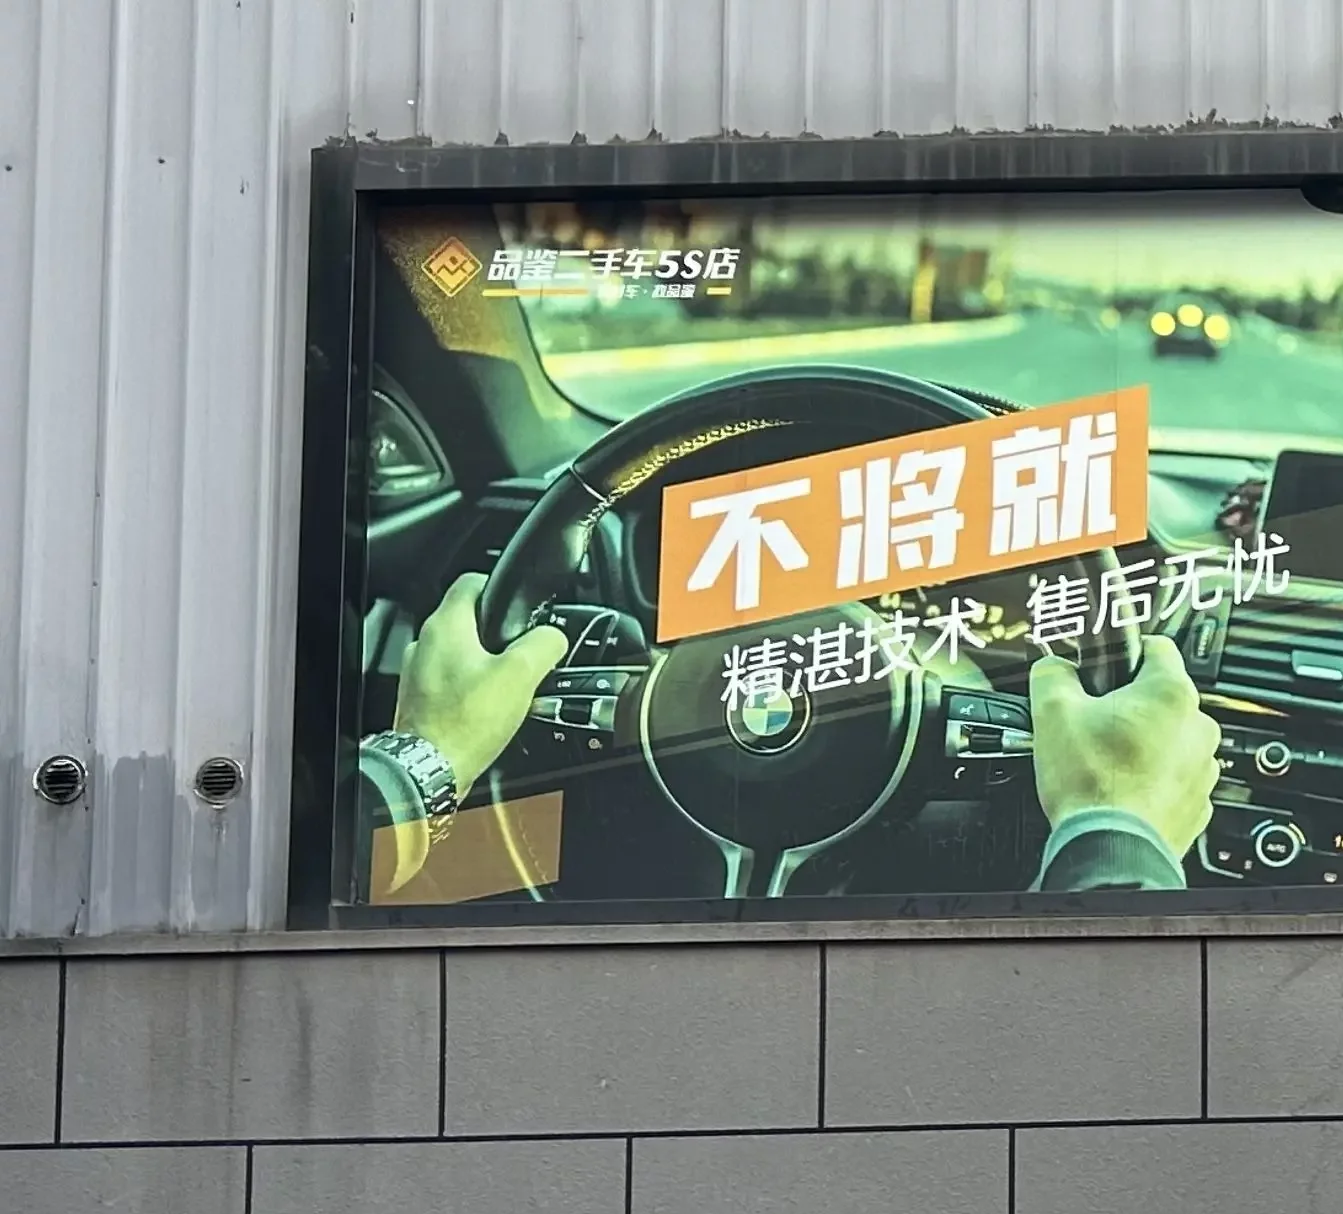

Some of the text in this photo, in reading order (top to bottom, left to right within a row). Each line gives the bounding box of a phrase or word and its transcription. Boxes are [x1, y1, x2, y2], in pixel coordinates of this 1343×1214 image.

[487, 247, 740, 281] 品鉴二手车5S店
[687, 411, 1118, 611] 不将就
[720, 533, 1291, 709] 精湛技术 售后无忧
